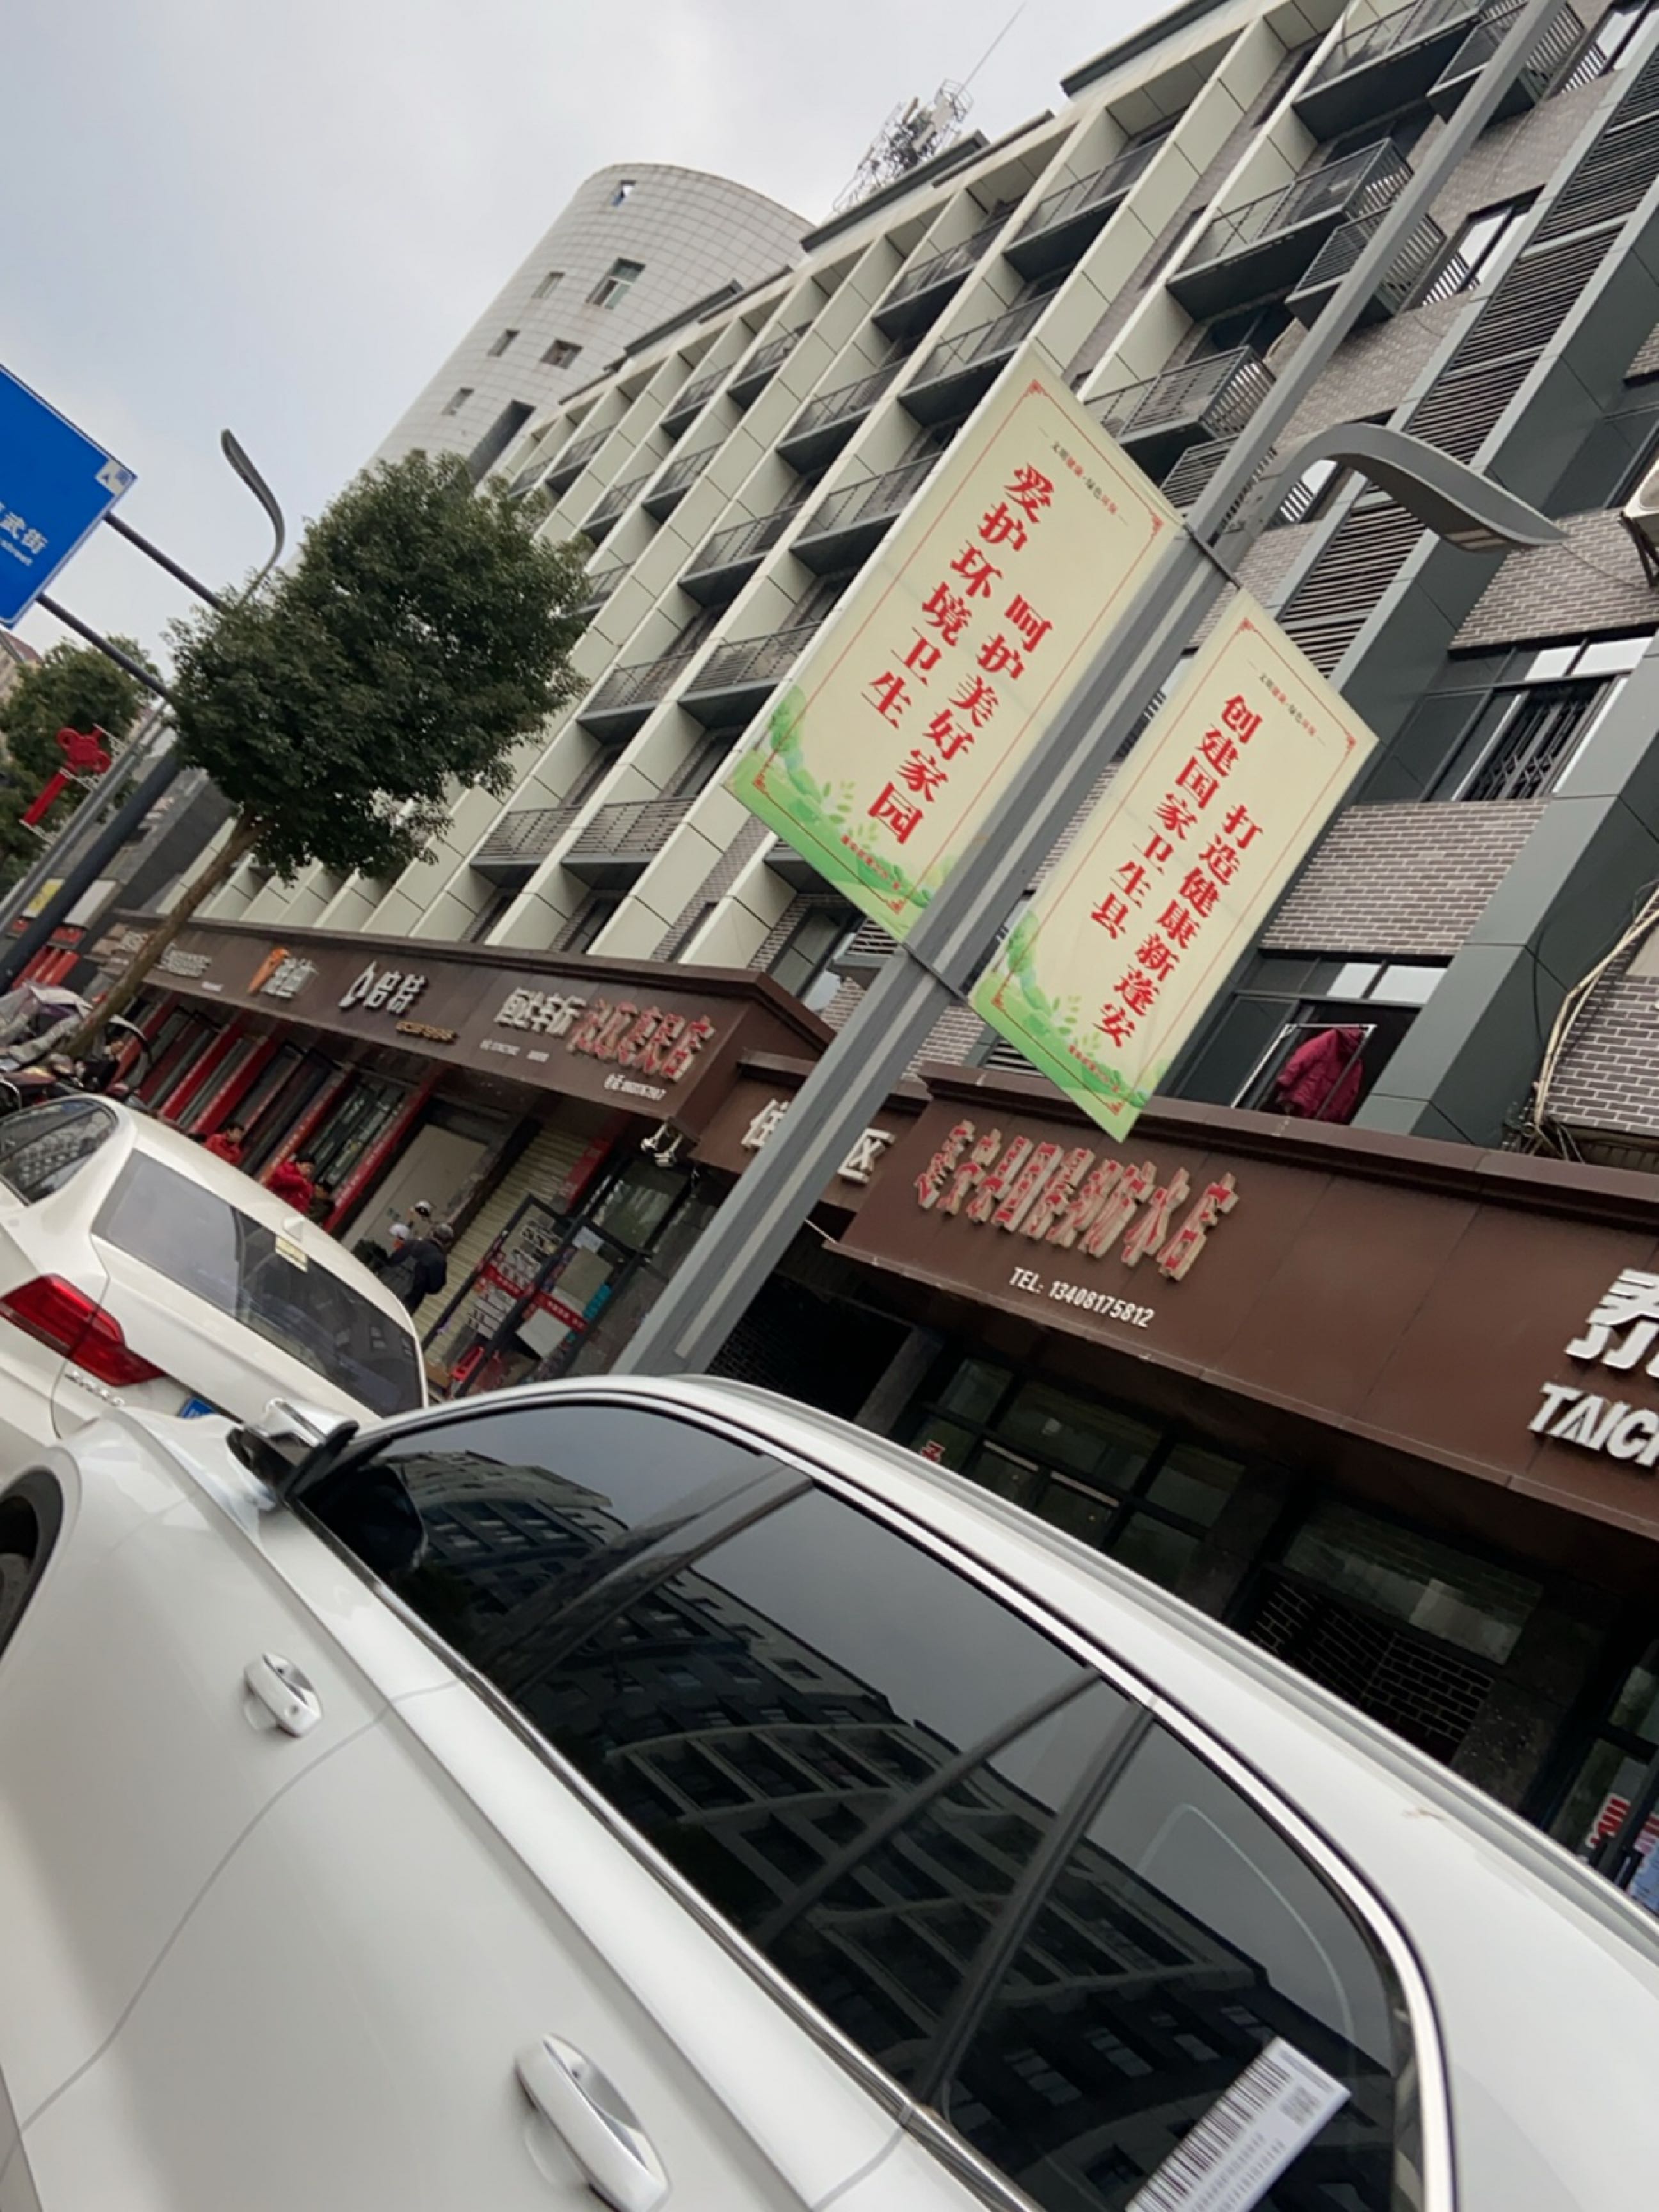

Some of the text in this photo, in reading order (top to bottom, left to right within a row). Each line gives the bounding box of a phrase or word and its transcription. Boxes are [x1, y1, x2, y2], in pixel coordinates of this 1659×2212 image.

[860, 463, 1055, 728] 爱护环境卫生
[868, 594, 1053, 844] 呵护美好家园
[1091, 694, 1263, 940] 创建国家卫生县
[1092, 804, 1263, 1048] 打造健康新蓬安
[1009, 1267, 1155, 1328] TEL: 13408175812
[1527, 1382, 1659, 1468] TAIC
